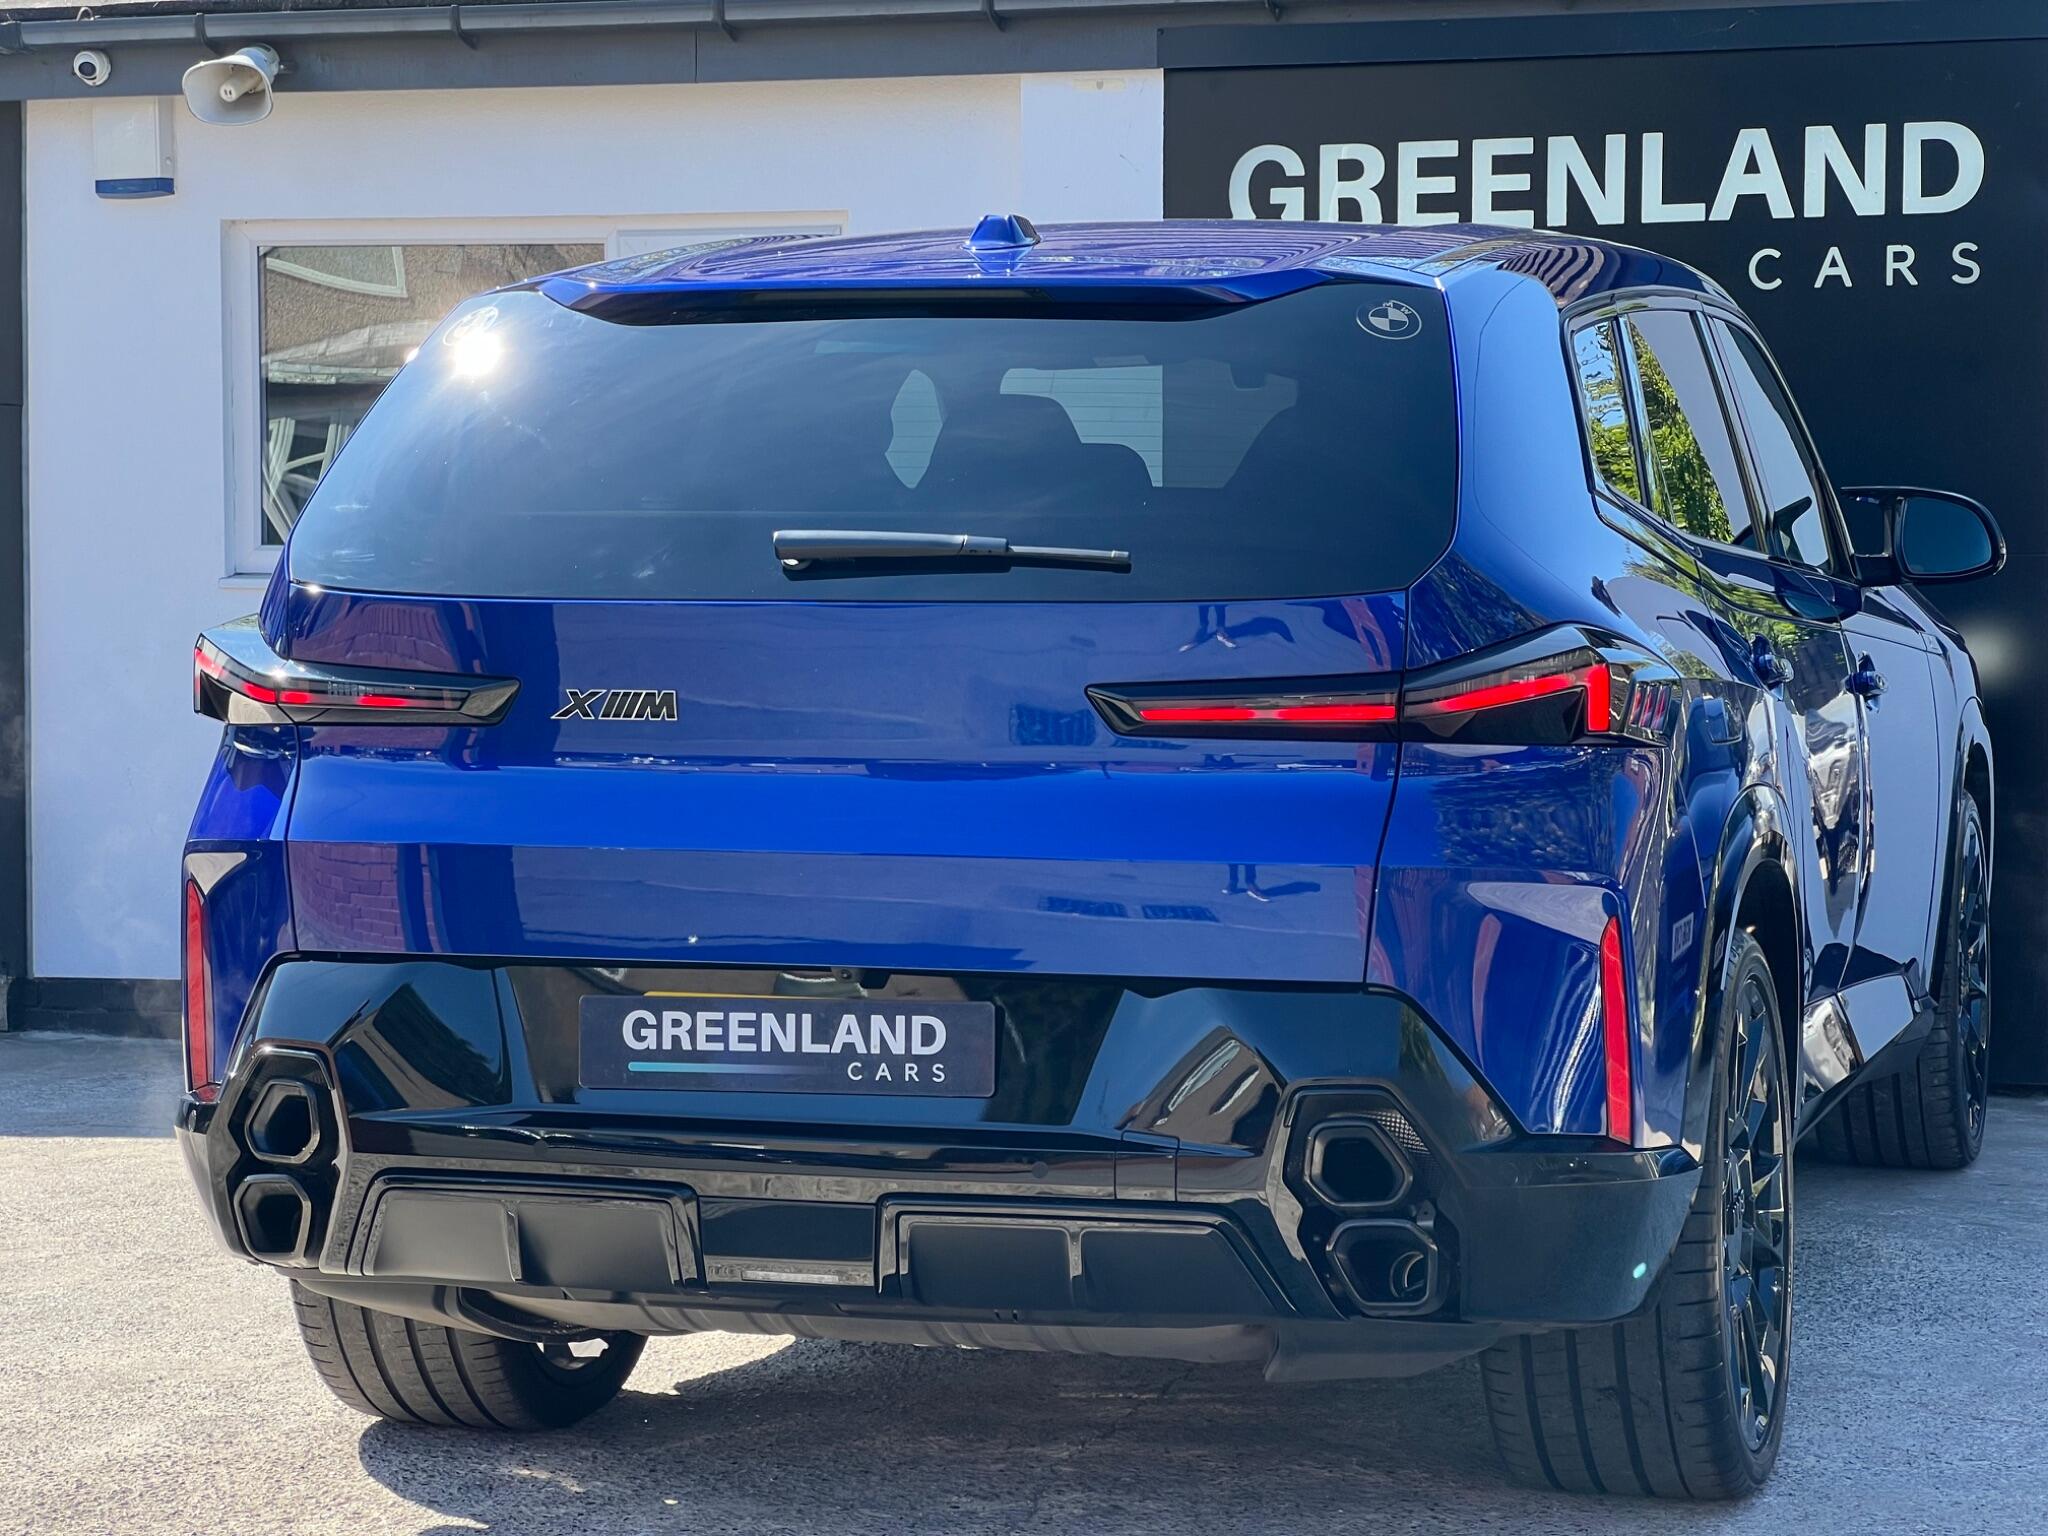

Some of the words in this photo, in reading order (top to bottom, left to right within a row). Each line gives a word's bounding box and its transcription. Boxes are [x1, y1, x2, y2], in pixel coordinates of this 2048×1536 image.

[1228, 121, 1985, 227] GREENLAND
[1749, 242, 1982, 290] CARS
[622, 1009, 947, 1055] GREENLAND
[847, 1062, 946, 1083] CARS
